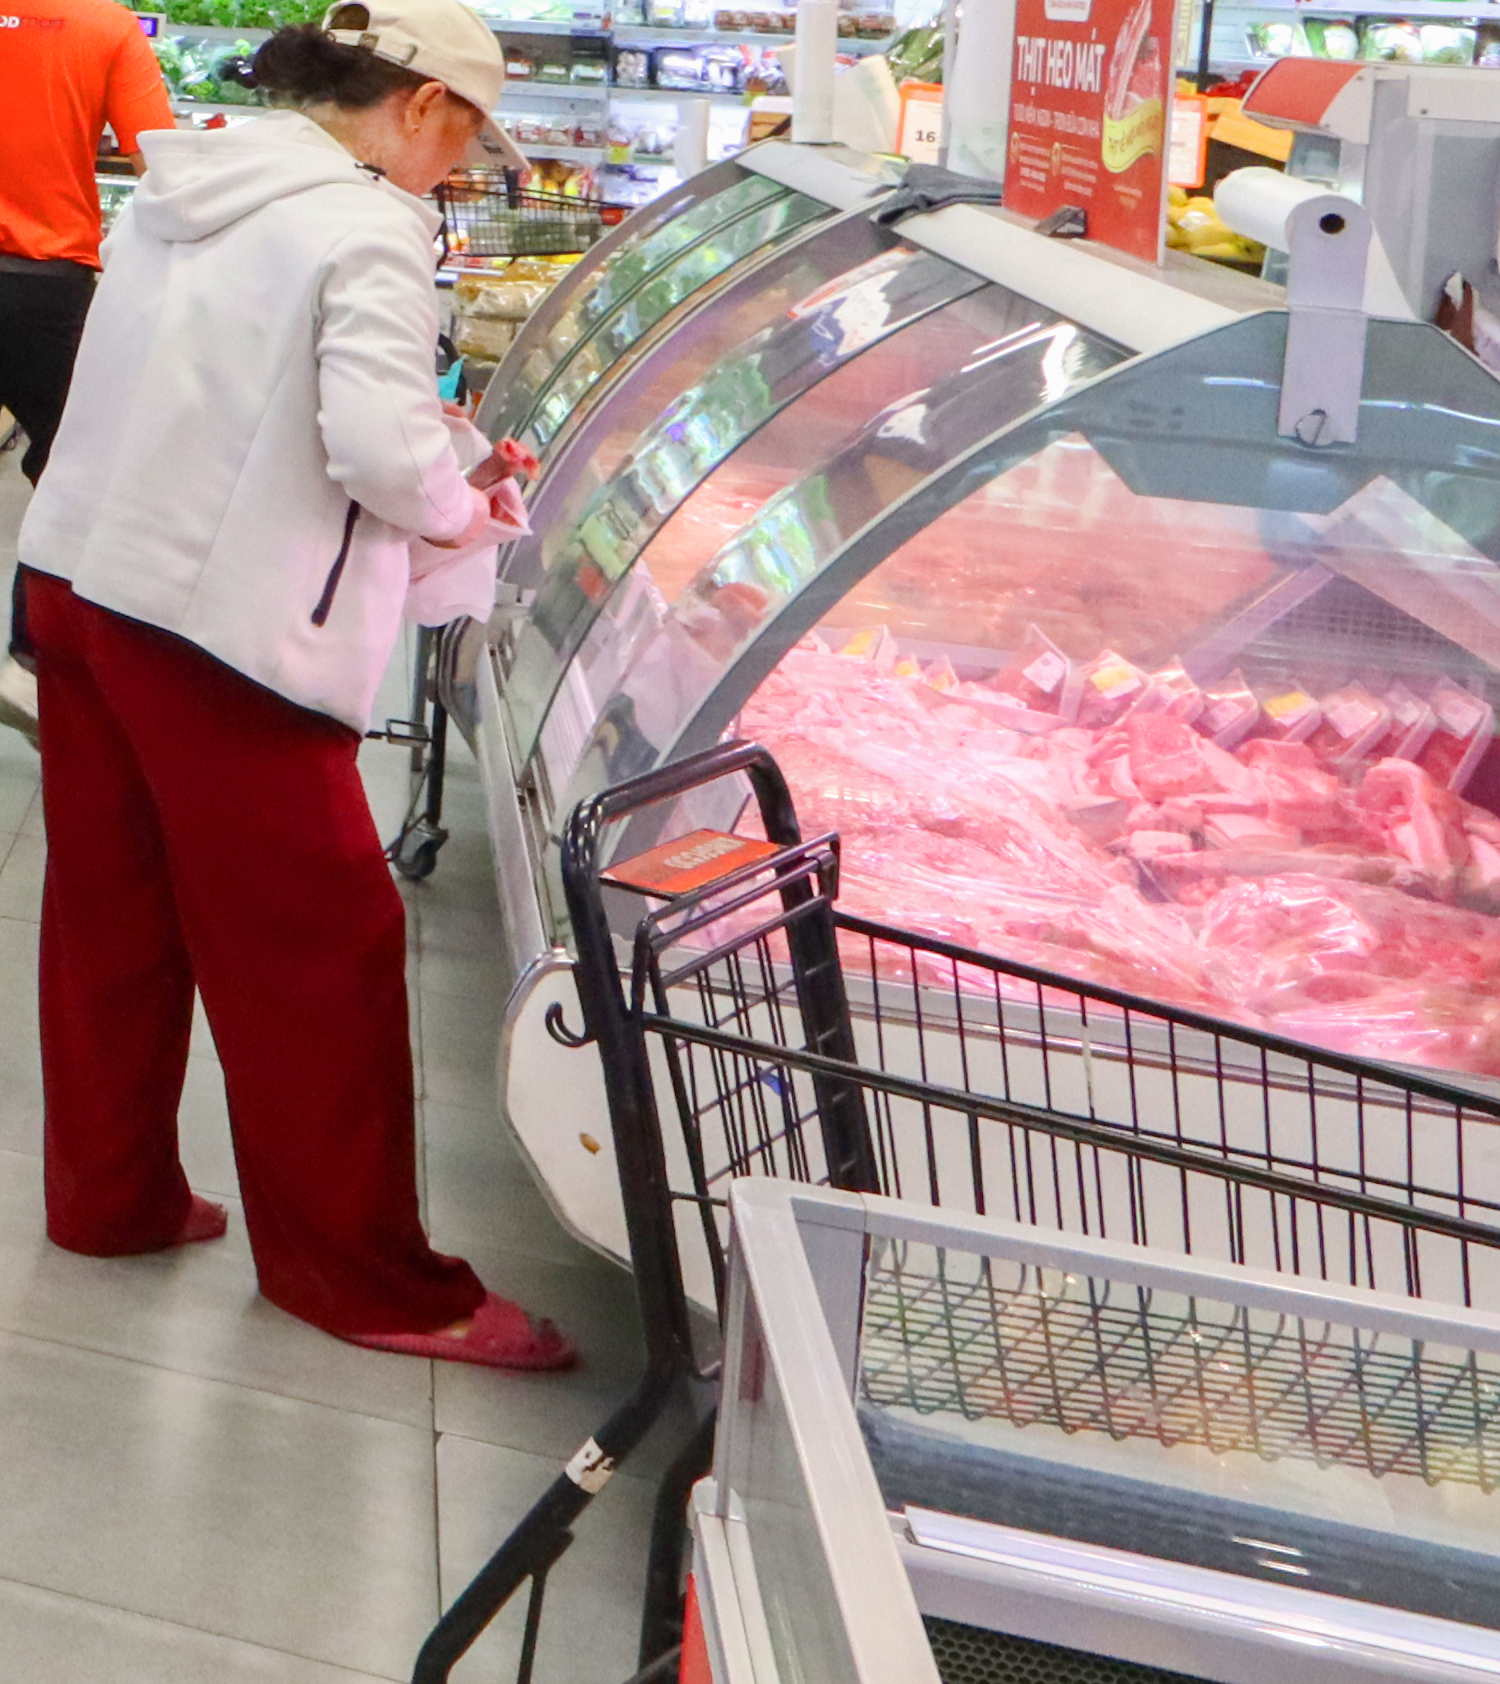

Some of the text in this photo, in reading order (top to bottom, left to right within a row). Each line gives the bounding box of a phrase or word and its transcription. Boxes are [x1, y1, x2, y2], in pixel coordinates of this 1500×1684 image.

[1017, 27, 1106, 97] THỊT HEO MÁT
